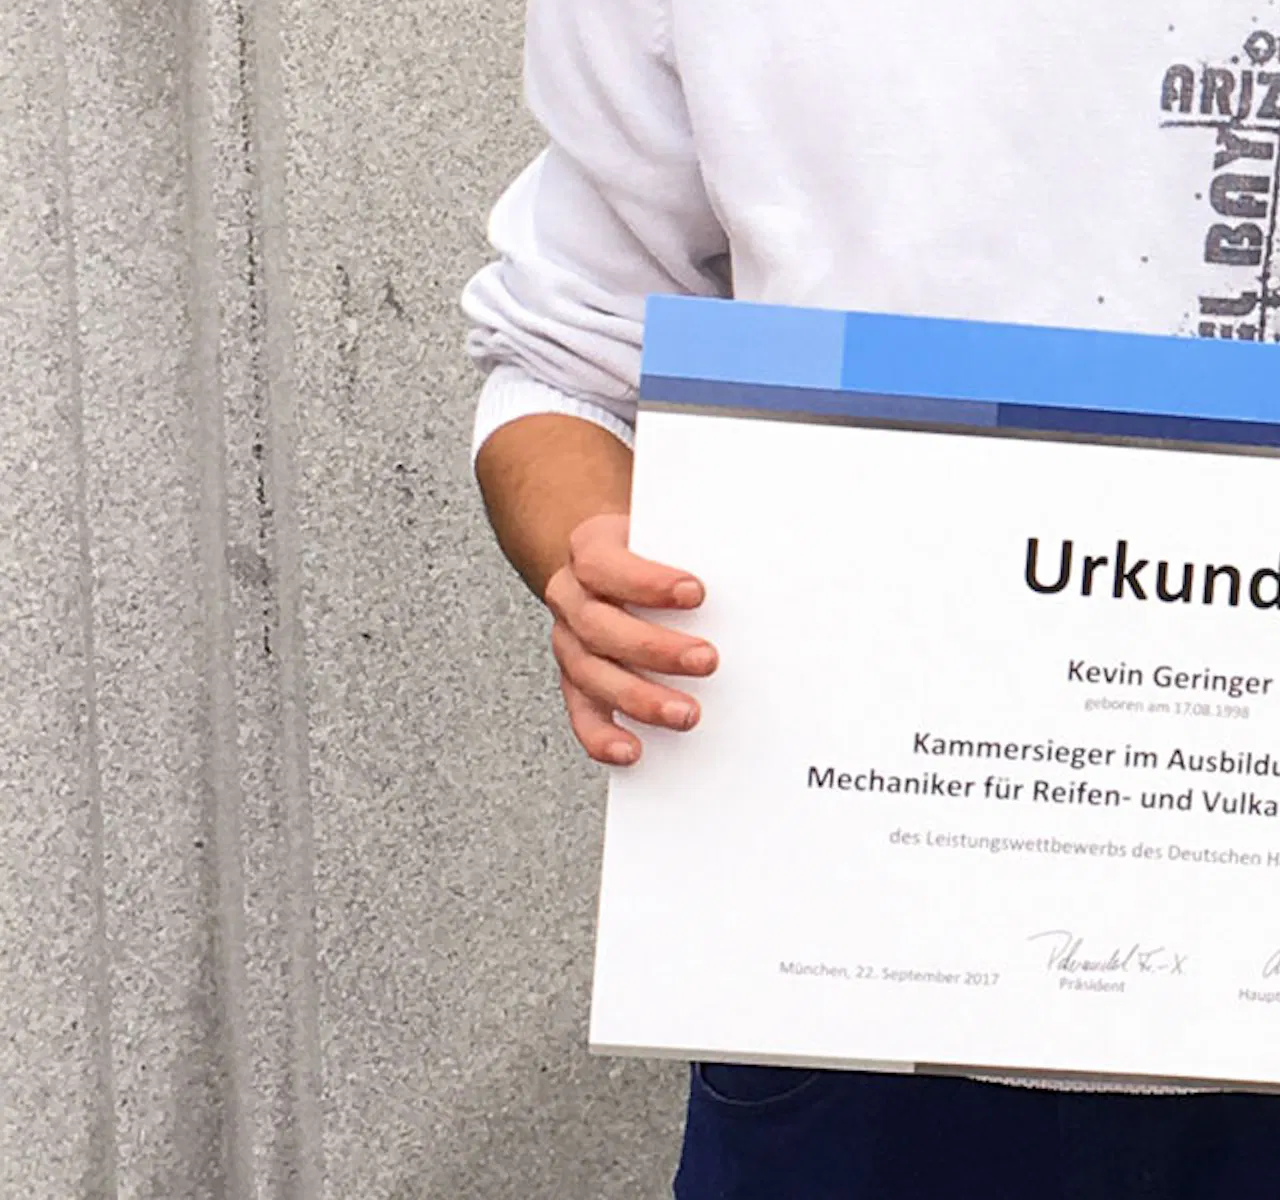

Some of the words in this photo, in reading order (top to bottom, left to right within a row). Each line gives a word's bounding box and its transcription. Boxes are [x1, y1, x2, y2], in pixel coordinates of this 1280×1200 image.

[1204, 126, 1274, 266] BAY
[1067, 659, 1143, 686] Kevin
[1152, 665, 1274, 699] Geringer
[1083, 696, 1145, 714] geboren
[1147, 702, 1171, 715] am
[913, 732, 1116, 770] Kammersieger
[1124, 744, 1158, 769] im
[807, 765, 976, 798] Mechaniker
[983, 775, 1025, 801] für
[1032, 779, 1131, 807] Reifen-
[1140, 788, 1193, 811] und
[888, 827, 921, 846] des
[925, 829, 1128, 859] Leistungswettbewerbs
[1131, 841, 1164, 860] des
[1167, 844, 1263, 866] Deutschen
[779, 960, 851, 980] München,
[881, 966, 961, 985] September
[963, 971, 1000, 987] 2017
[1059, 976, 1126, 993] Präsident
